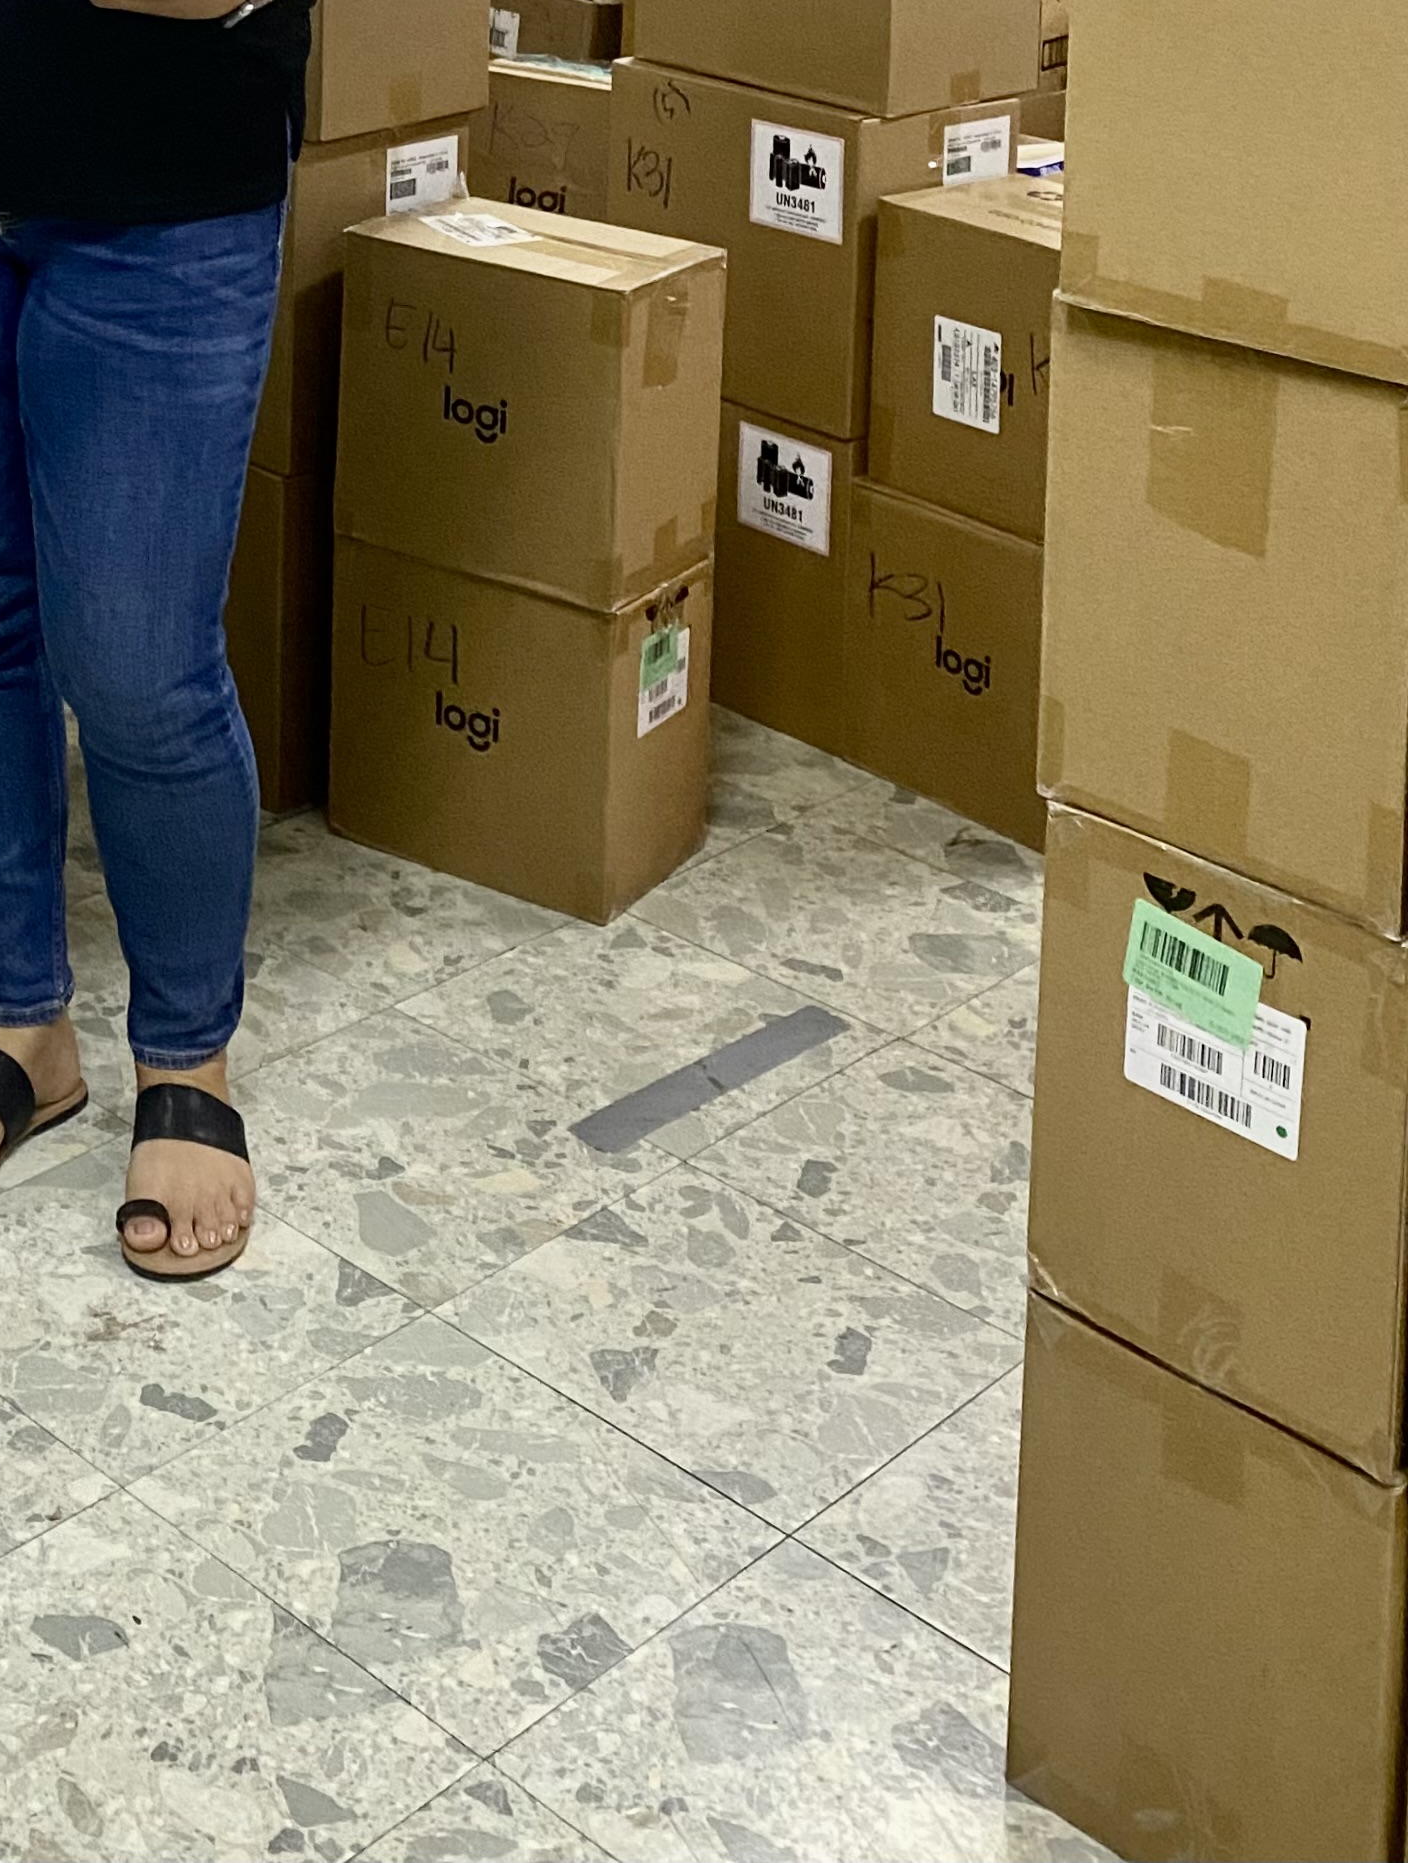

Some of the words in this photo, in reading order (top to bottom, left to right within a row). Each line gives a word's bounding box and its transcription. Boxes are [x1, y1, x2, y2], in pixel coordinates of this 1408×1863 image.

[626, 137, 672, 209] K31
[776, 192, 815, 213] UN3481
[385, 298, 458, 374] E14
[442, 385, 508, 444] logi
[763, 496, 804, 524] UN3481
[869, 551, 945, 637] K31
[361, 603, 459, 685] E14
[935, 635, 992, 696] logi
[435, 690, 501, 753] logi
